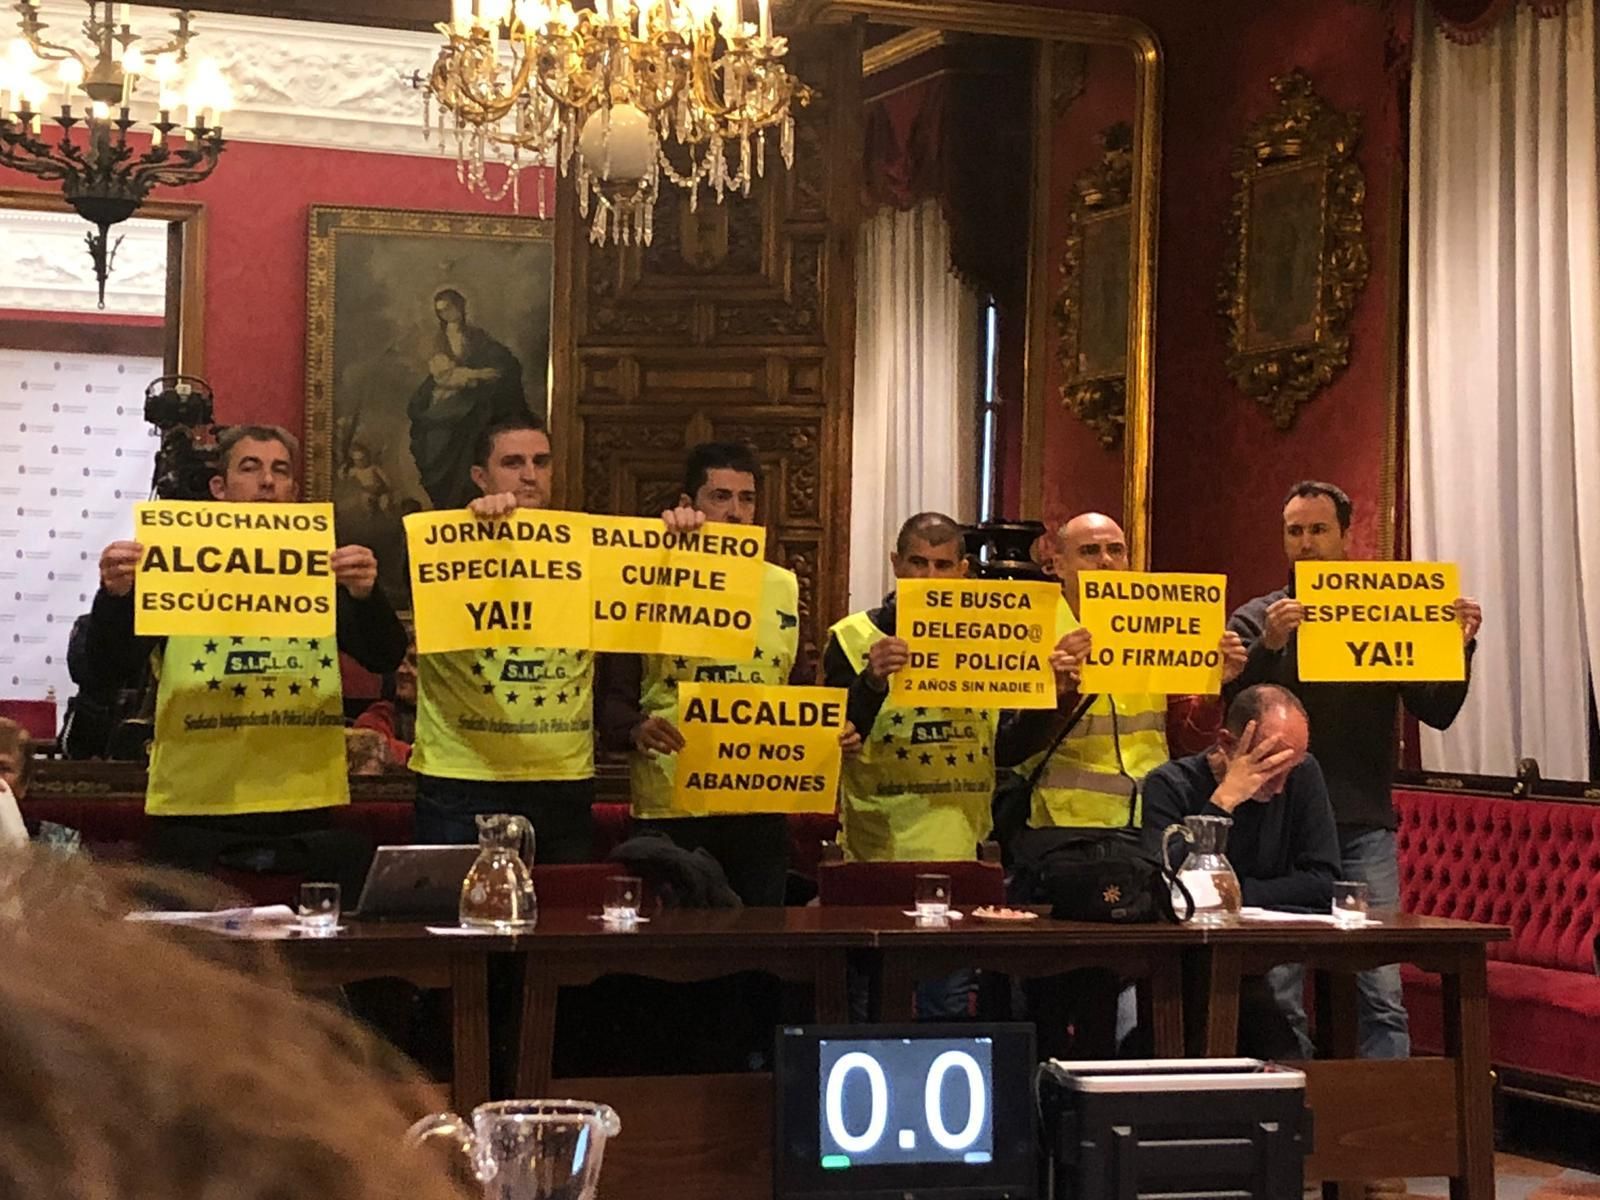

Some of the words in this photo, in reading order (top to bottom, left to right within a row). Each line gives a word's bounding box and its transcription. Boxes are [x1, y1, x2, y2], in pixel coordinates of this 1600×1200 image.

[141, 508, 328, 532] ESCÚCHANOS
[425, 521, 571, 545] JORNADAS
[592, 527, 759, 558] BALDOMERO
[142, 545, 329, 577] ALCALDE
[418, 558, 582, 584] ESPECIALES
[622, 565, 726, 591] CUMPLE
[1312, 573, 1445, 590] JORNADAS
[142, 588, 330, 613] ESCÚCHANOS
[926, 590, 953, 607] SE
[961, 592, 1031, 609] BUSCA
[1085, 581, 1221, 604] BALDOMERO
[465, 600, 532, 631] YA!!
[595, 600, 627, 621] LO
[636, 602, 752, 631] FIRMADO
[1111, 615, 1200, 635] CUMPLE
[1304, 605, 1456, 622] ESPECIALES
[911, 652, 939, 669] DE
[955, 650, 1041, 671] POLICÍA
[1085, 648, 1114, 666] LO
[1122, 648, 1219, 667] FIRMADO
[1346, 641, 1414, 666] YA!!
[904, 679, 912, 691] 2
[918, 678, 957, 692] AÑOS
[962, 680, 984, 692] SIN
[989, 681, 1031, 693] NADIE
[684, 698, 840, 727] ALCALDE
[719, 743, 751, 760] NO
[759, 744, 805, 761] NOS
[686, 773, 825, 792] ABANDONES
[826, 1050, 986, 1152] 0.0
